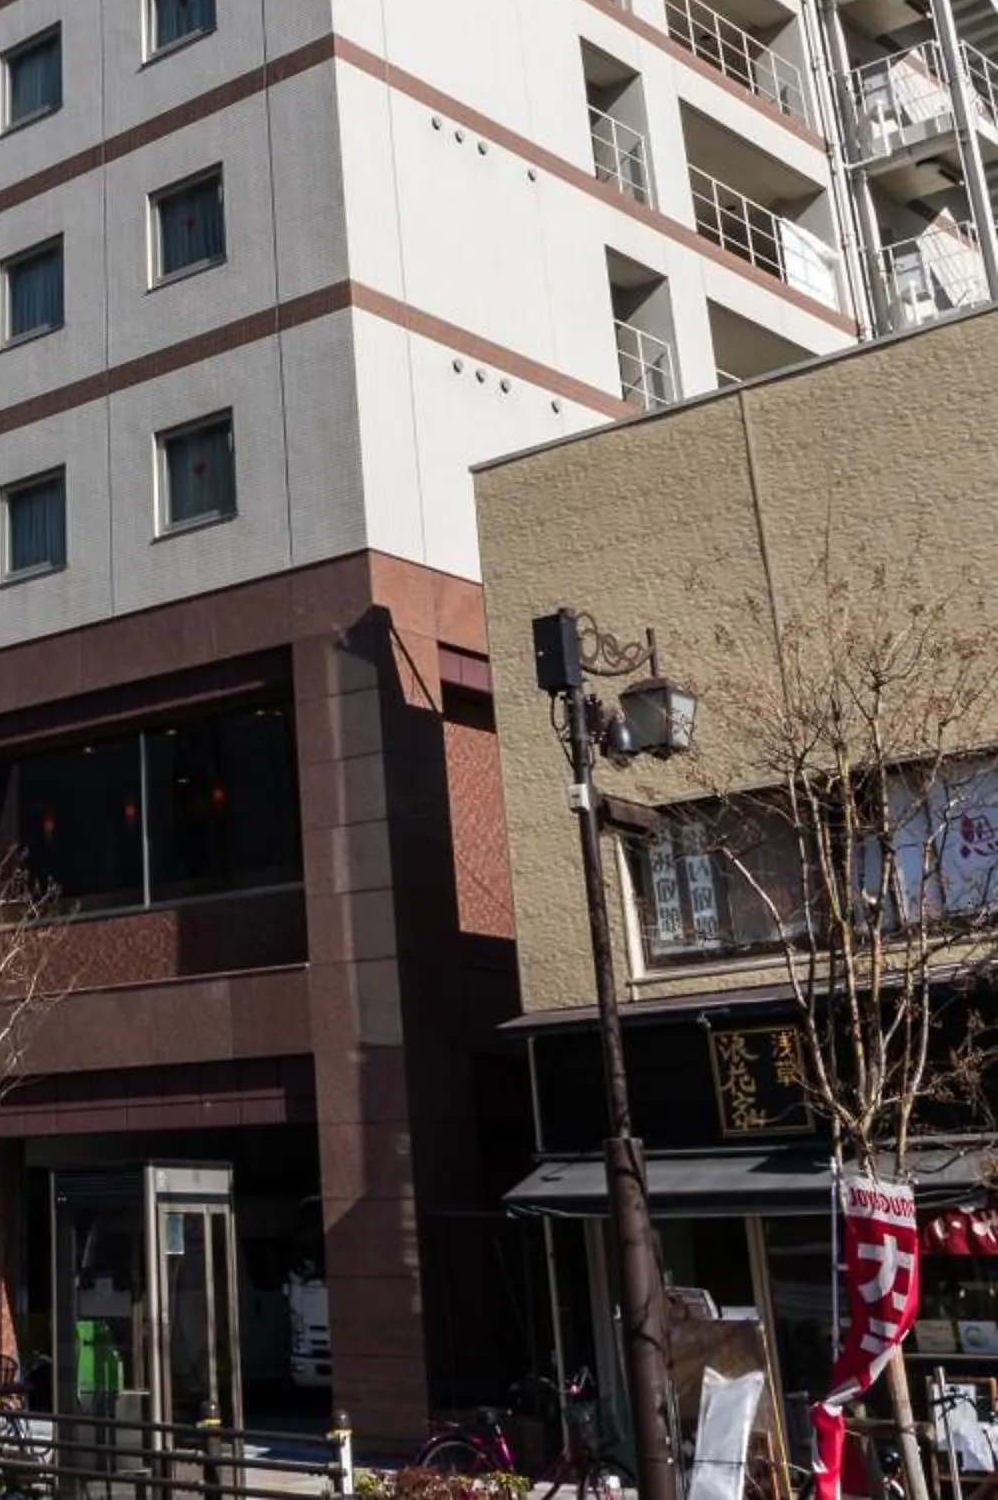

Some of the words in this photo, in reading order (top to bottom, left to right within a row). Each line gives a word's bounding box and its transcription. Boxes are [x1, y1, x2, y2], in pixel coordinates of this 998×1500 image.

[652, 823, 684, 940] み放題
[683, 823, 718, 940] い放題
[771, 1030, 798, 1088] 浅草
